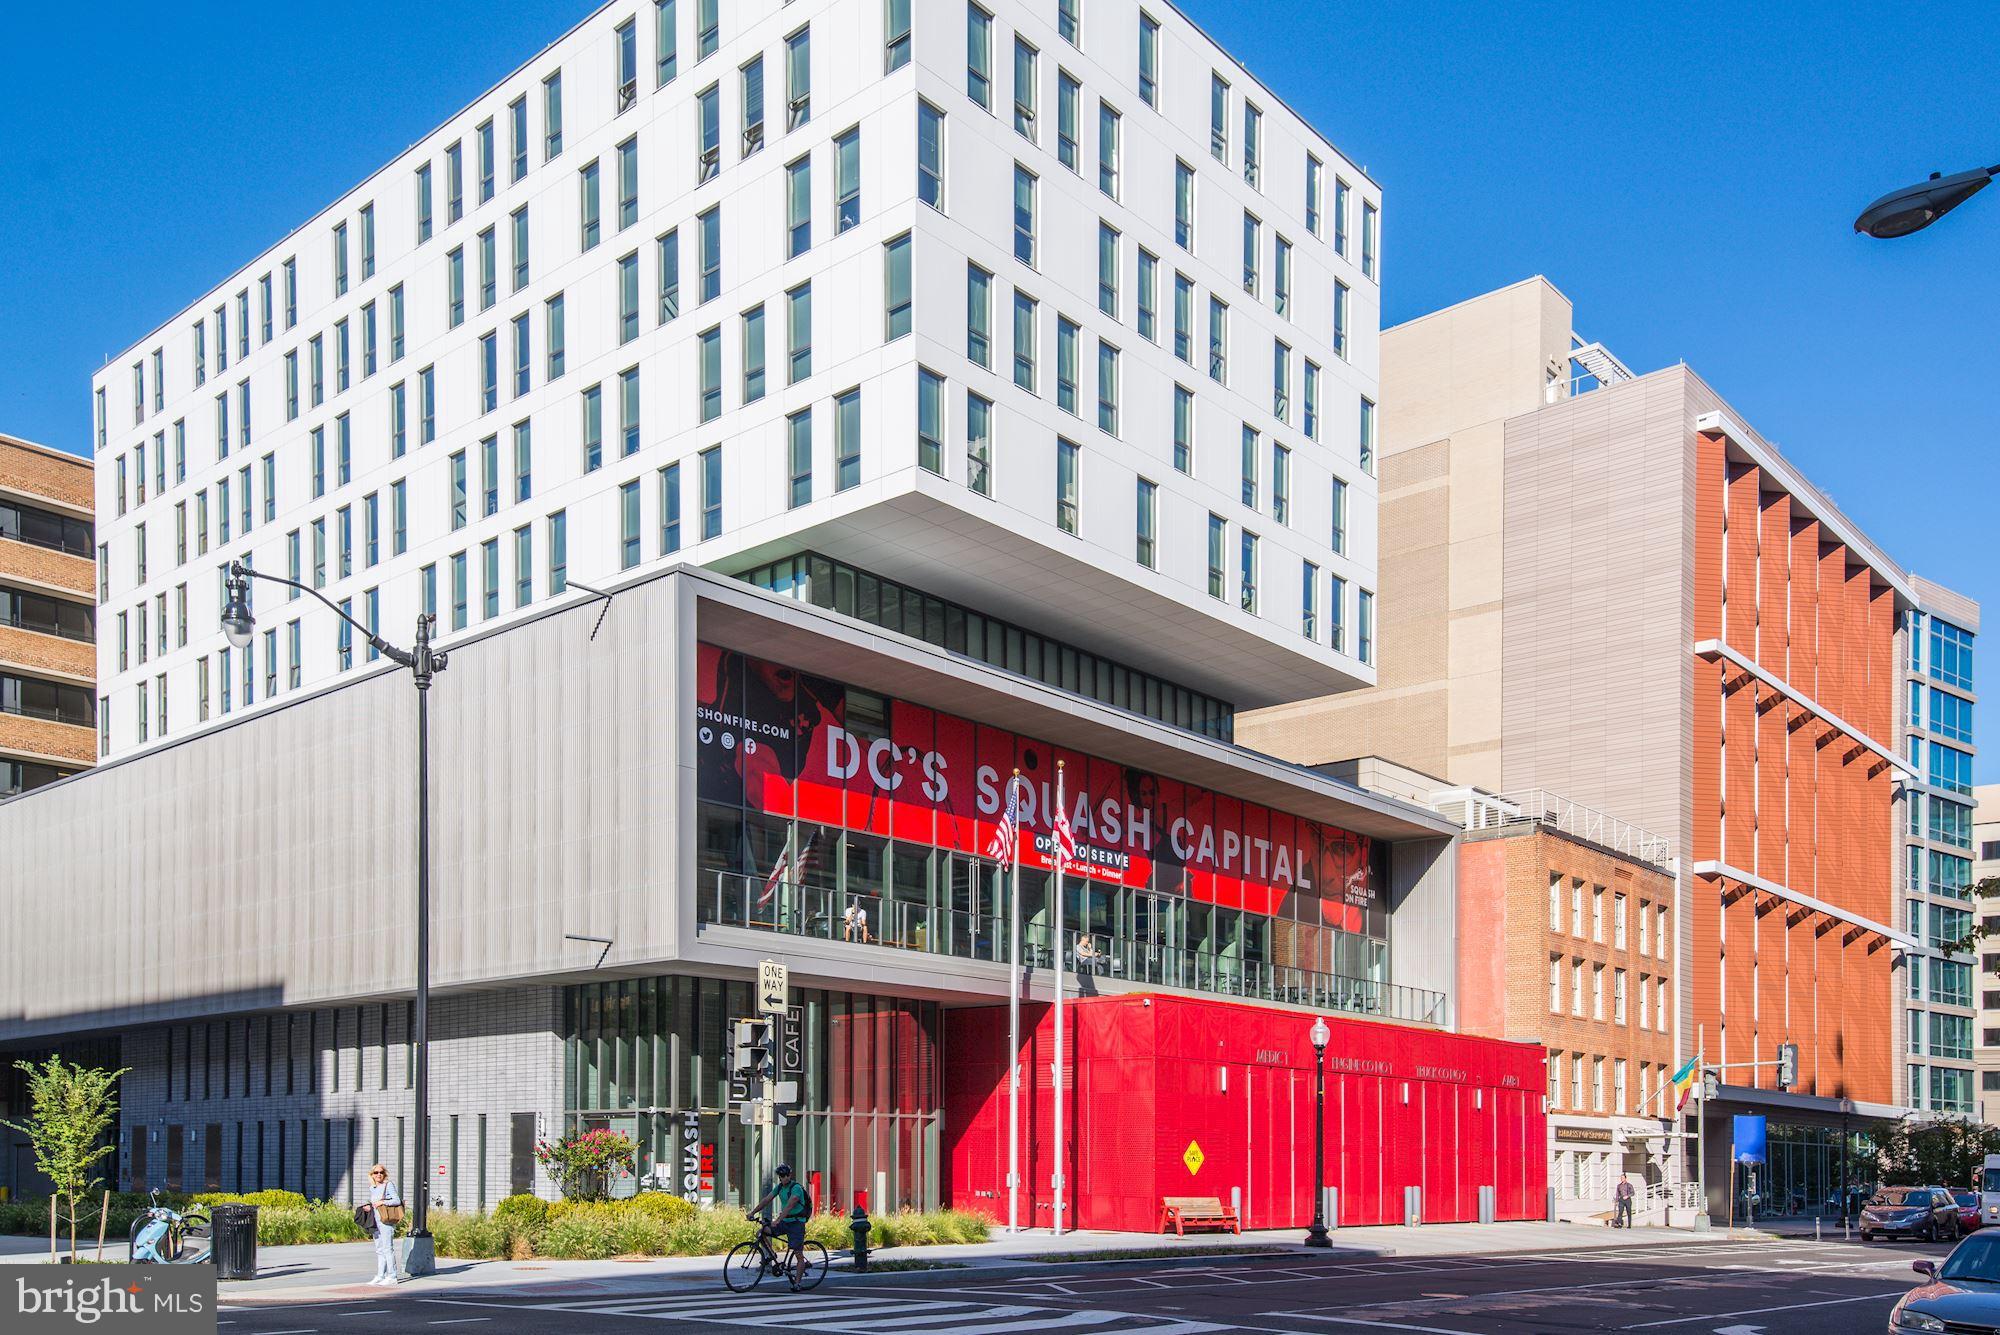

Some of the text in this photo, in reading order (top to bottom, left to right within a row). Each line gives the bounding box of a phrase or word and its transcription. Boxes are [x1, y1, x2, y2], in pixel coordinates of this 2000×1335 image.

[976, 764, 1151, 851] SQUASH
[1170, 816, 1312, 889] CAPITAL
[1035, 836, 1069, 853] OPE
[1091, 849, 1129, 867] SERVE
[1076, 862, 1096, 874] Lunch
[1350, 884, 1376, 899] SQUASH
[763, 979, 784, 992] WAY
[764, 965, 783, 979] ONE
[785, 1010, 800, 1068] CAFE
[684, 1110, 699, 1203] SQUASH
[700, 1143, 715, 1191] FIRE
